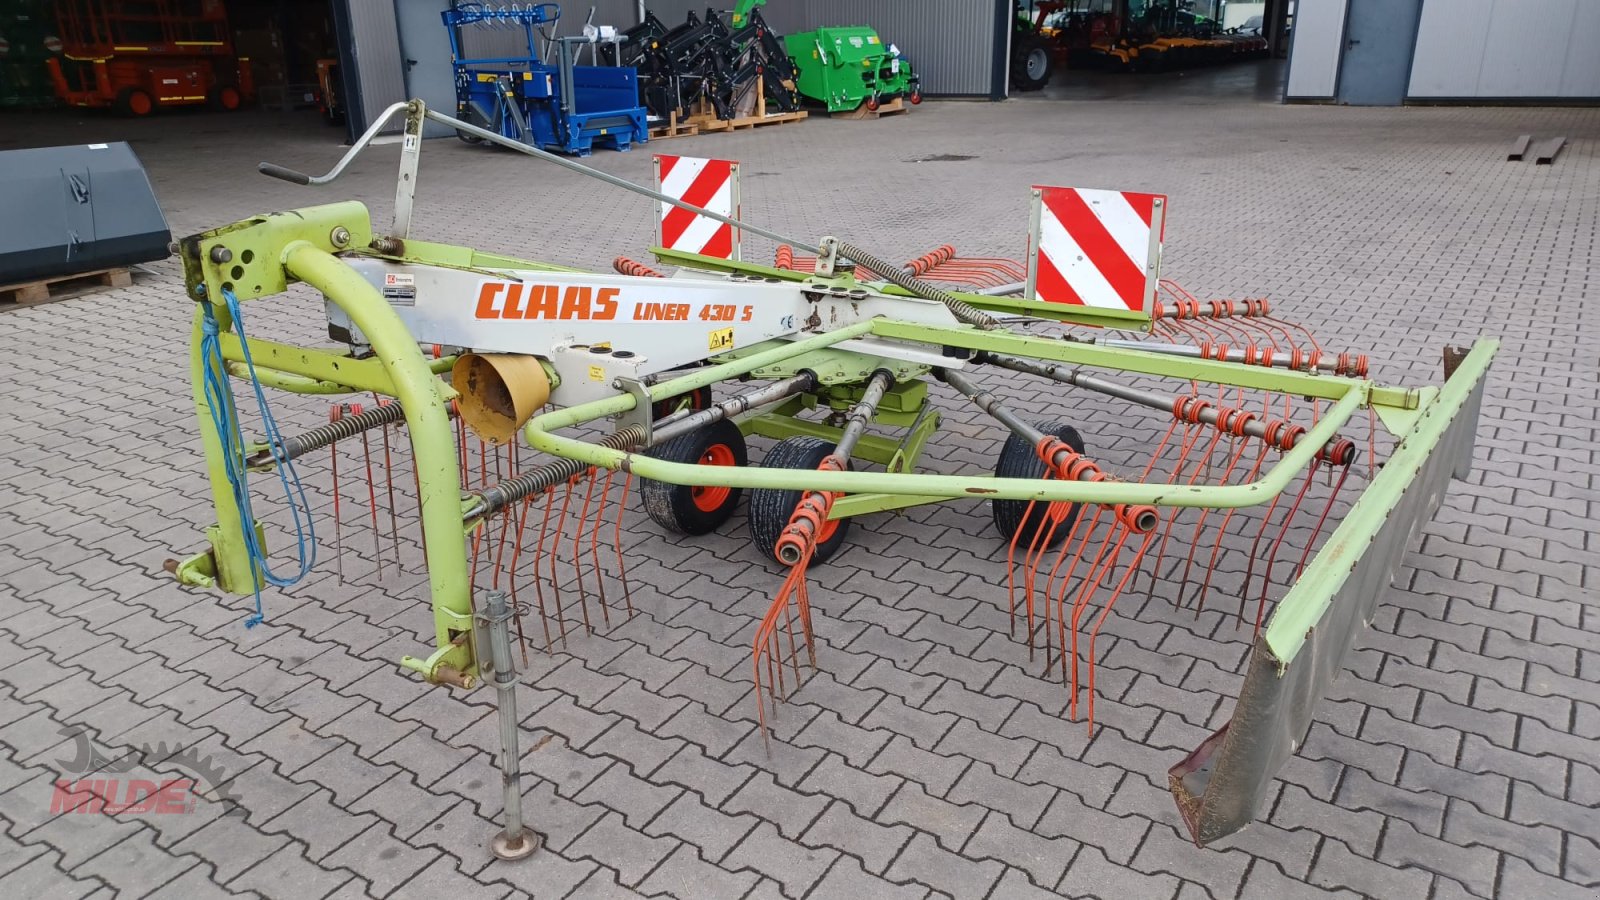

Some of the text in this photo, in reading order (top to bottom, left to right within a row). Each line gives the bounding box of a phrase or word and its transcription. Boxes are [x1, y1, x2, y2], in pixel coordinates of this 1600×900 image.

[475, 282, 753, 322] CLAAS LINER 430 S
